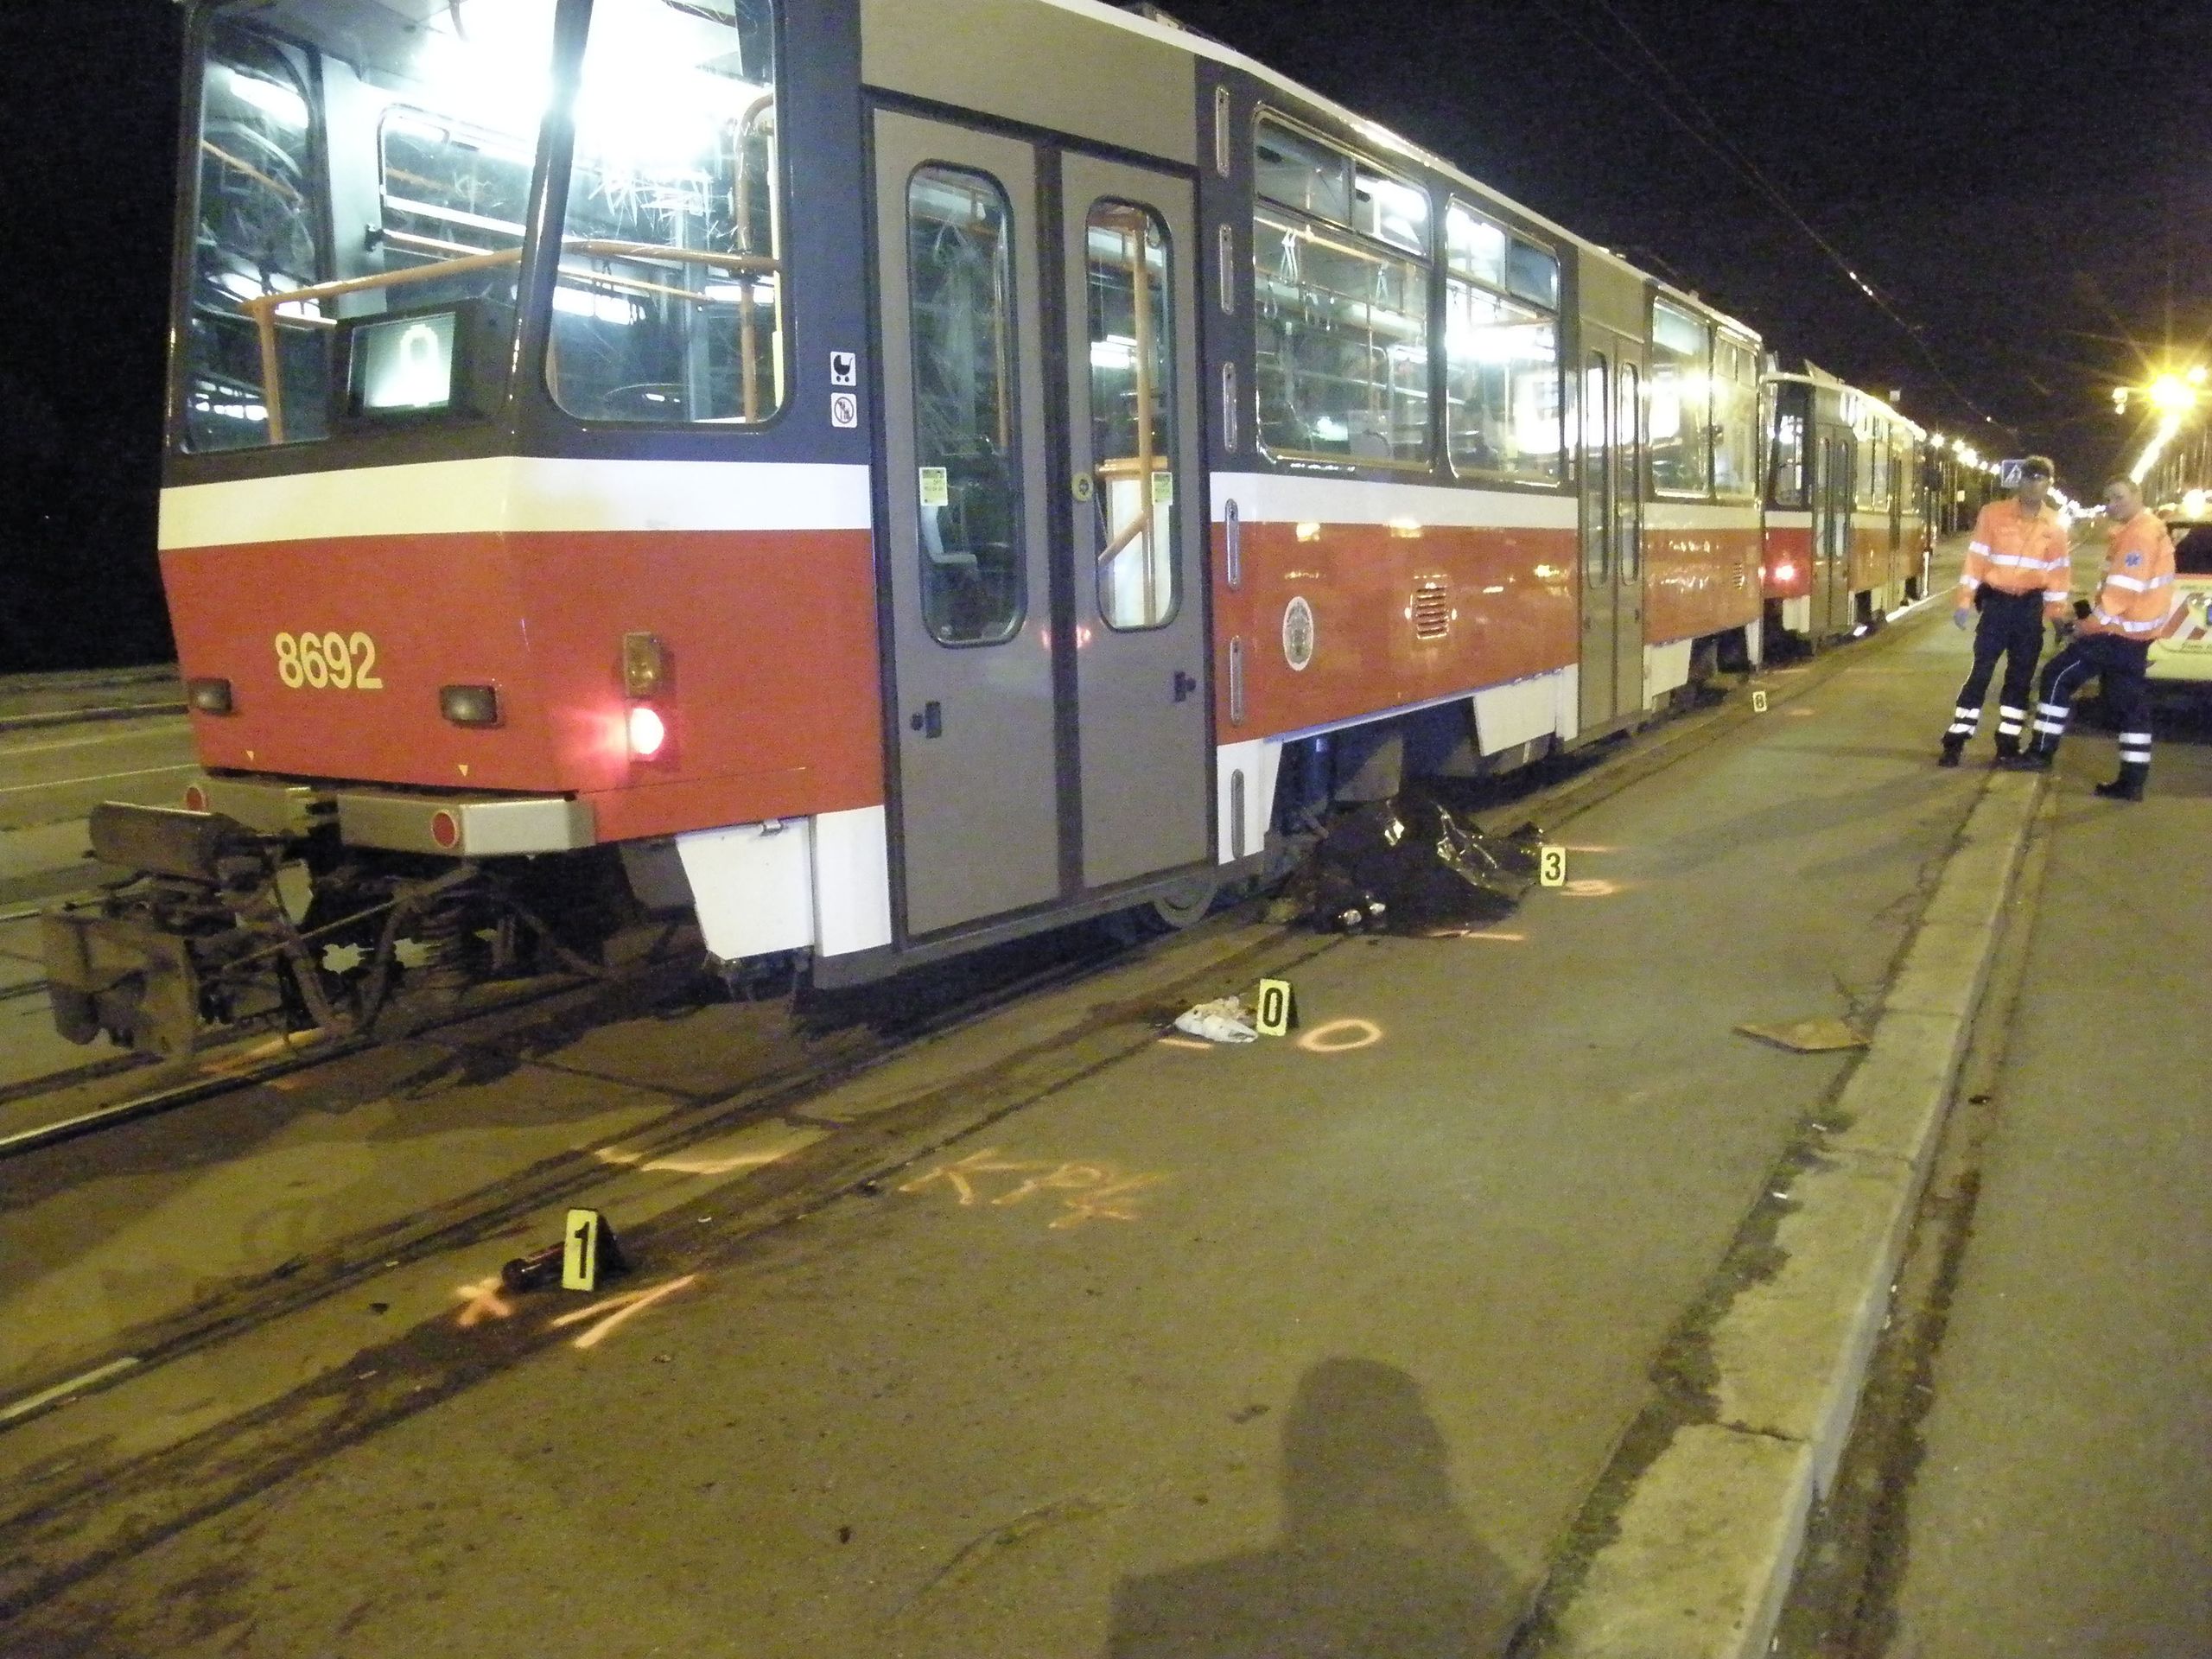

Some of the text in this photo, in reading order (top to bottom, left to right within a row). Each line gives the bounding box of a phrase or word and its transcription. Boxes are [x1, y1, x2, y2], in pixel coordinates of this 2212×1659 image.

[275, 632, 383, 689] 8692
[1545, 852, 1560, 880] 3
[1262, 987, 1283, 1027] 0
[574, 1220, 590, 1280] 1
